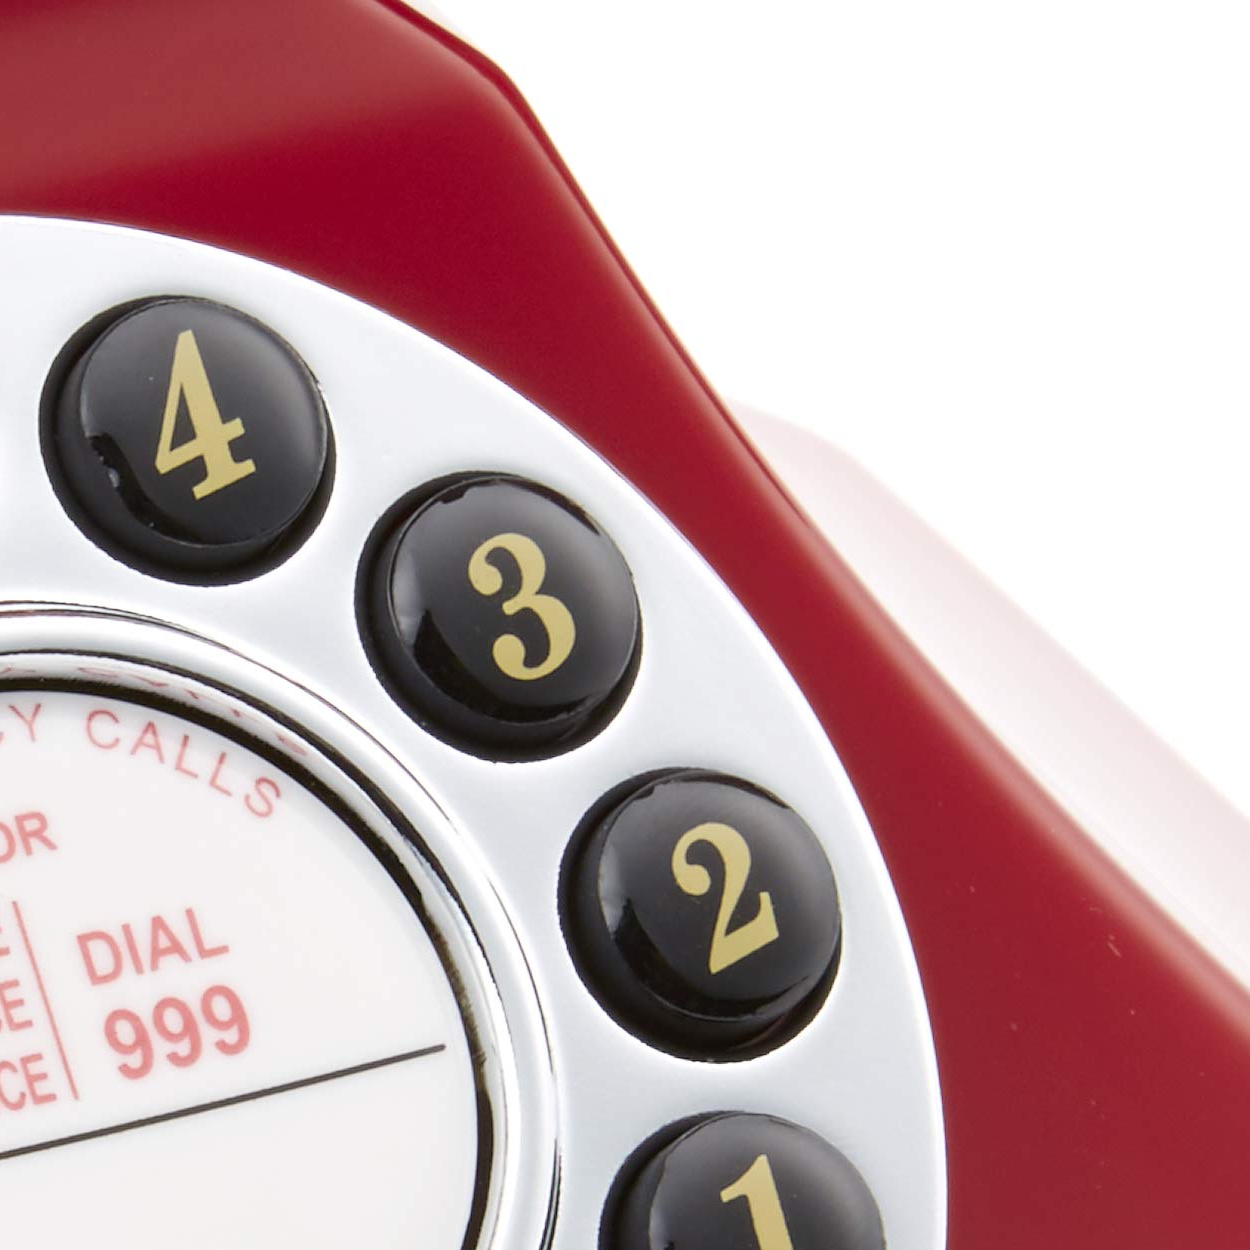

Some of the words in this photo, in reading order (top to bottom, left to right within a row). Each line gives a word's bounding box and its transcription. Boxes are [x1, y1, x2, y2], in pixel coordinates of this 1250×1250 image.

[154, 330, 256, 500] 4
[467, 532, 575, 682] 3
[83, 705, 284, 820] CALLS
[75, 905, 232, 988] DIAL
[670, 823, 778, 975] 2
[102, 982, 252, 1083] 999
